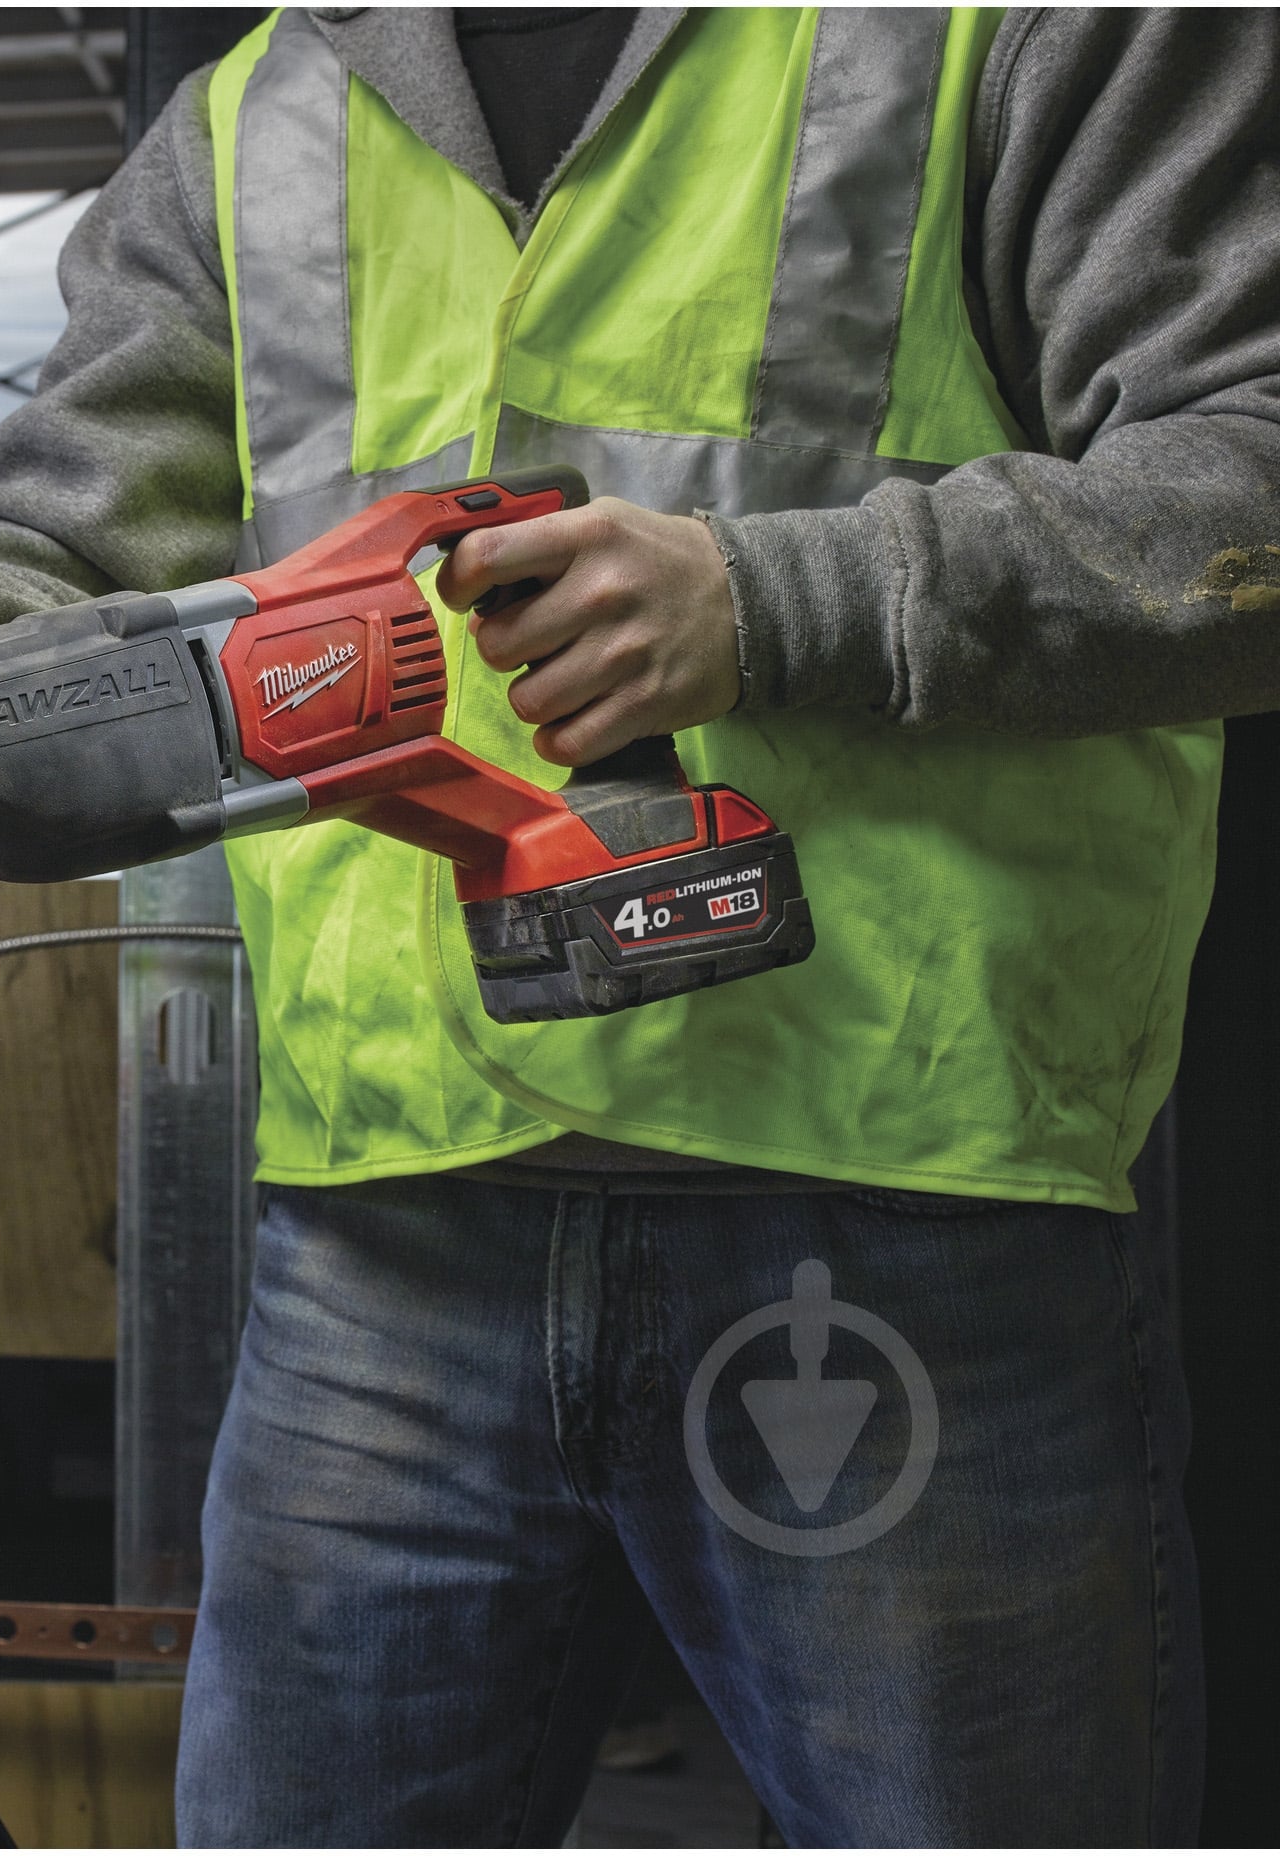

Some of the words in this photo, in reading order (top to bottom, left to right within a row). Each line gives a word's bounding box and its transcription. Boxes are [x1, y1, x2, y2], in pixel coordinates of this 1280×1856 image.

[253, 641, 358, 706] Milwaukee
[614, 898, 670, 938] 4.0
[709, 891, 756, 916] M18
